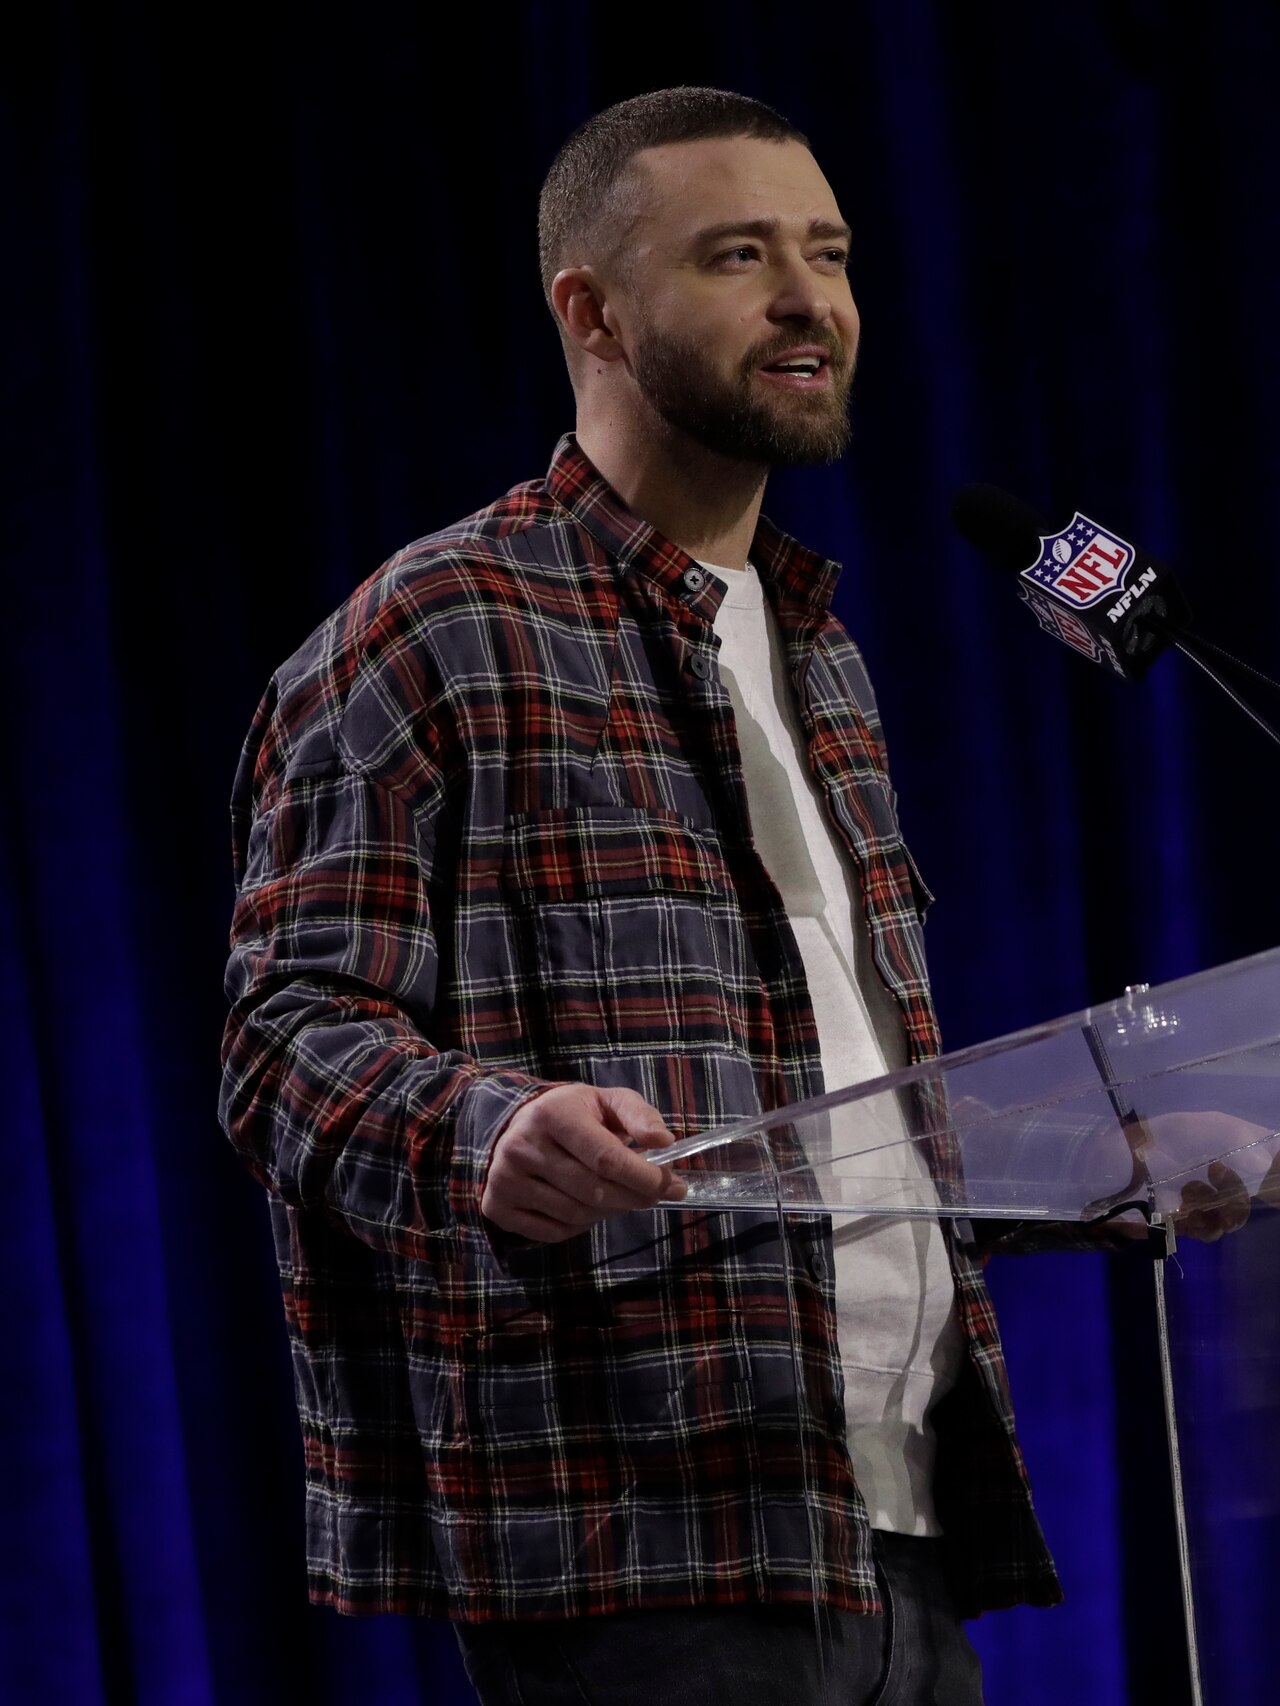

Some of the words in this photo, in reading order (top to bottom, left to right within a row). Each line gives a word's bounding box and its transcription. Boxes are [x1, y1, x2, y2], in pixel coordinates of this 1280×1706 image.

[1057, 543, 1125, 601] NFL
[1107, 567, 1158, 623] NFLN
[1053, 608, 1094, 657] NFL
